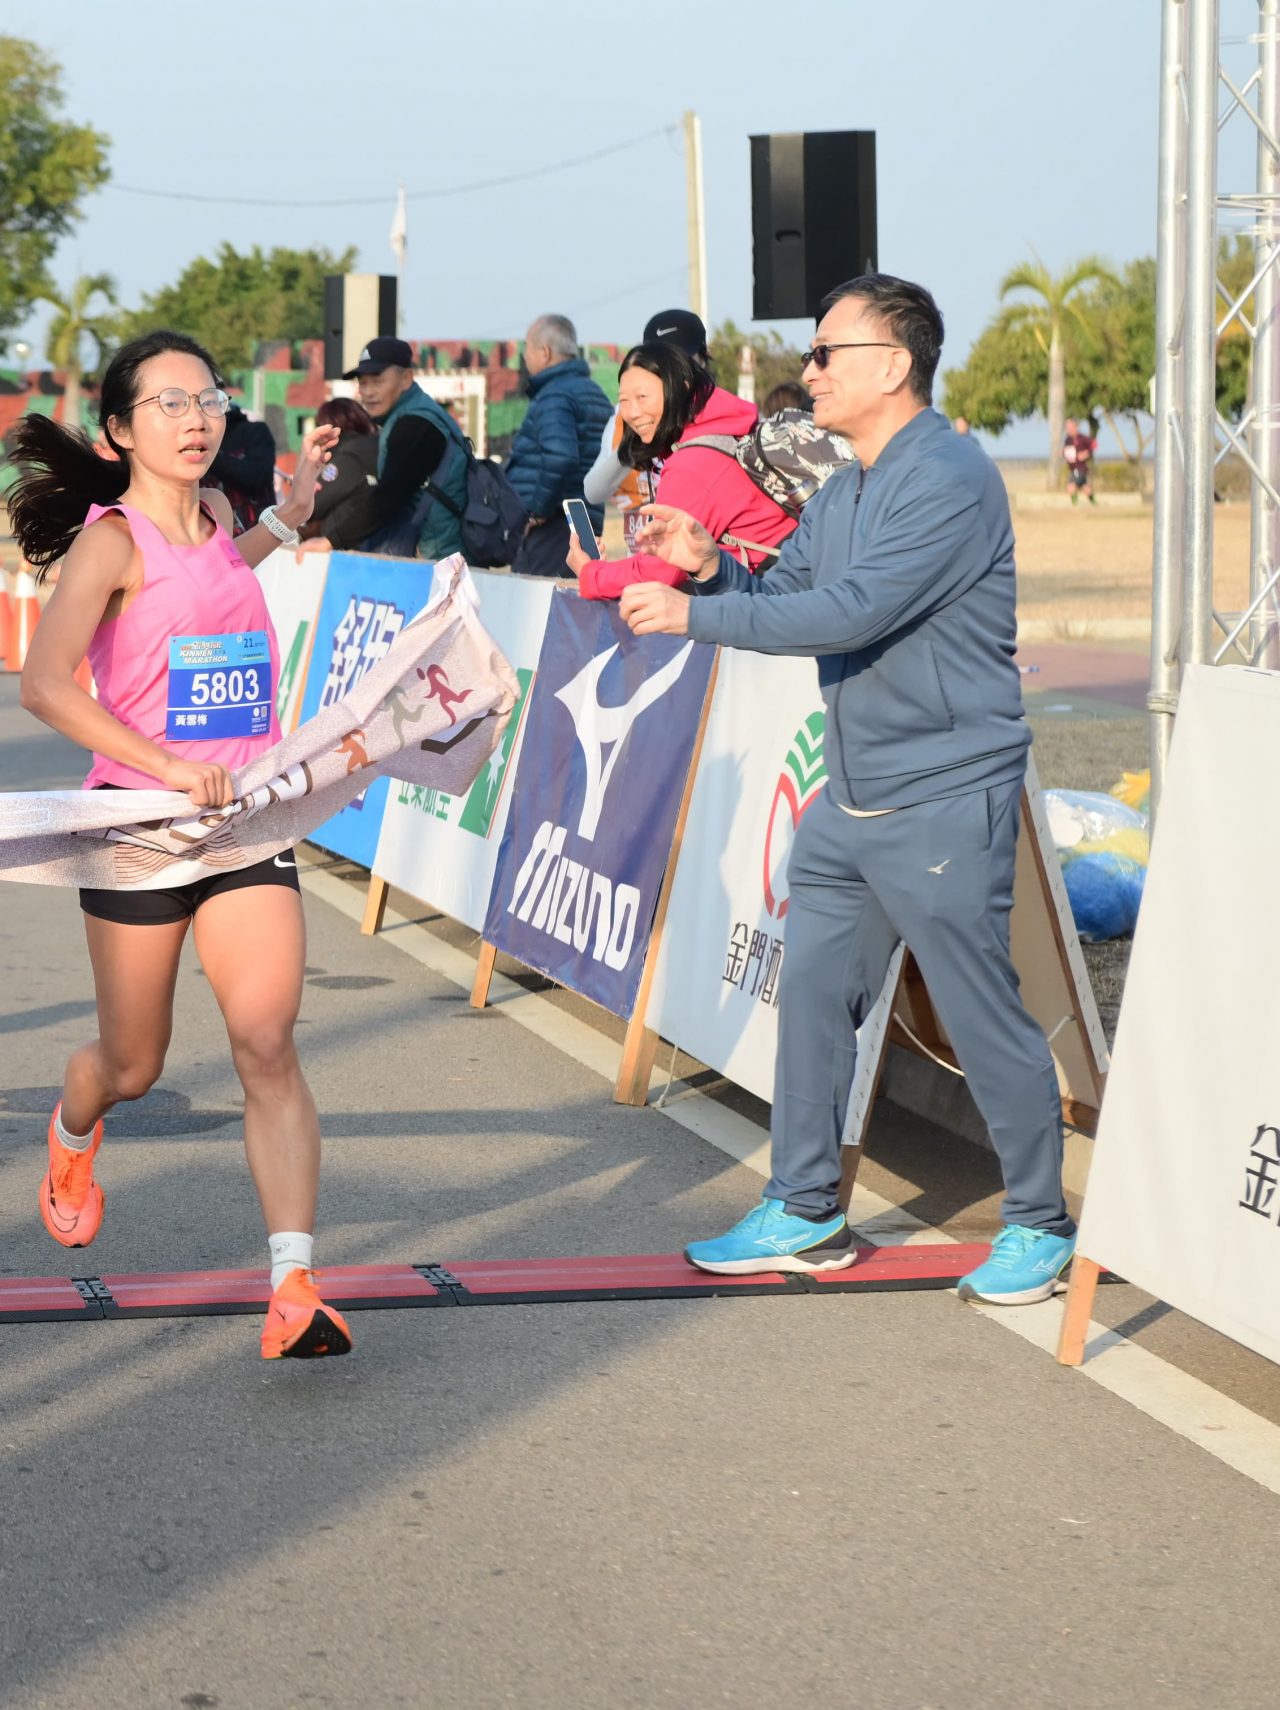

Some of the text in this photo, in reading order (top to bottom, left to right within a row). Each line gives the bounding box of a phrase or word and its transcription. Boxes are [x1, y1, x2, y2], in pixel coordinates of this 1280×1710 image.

[179, 649, 213, 658] KINMEN
[243, 637, 254, 649] 21
[183, 655, 228, 665] MARATHON
[190, 668, 260, 706] 5803
[722, 921, 785, 1009] 金門酒
[1238, 1122, 1280, 1228] 金
